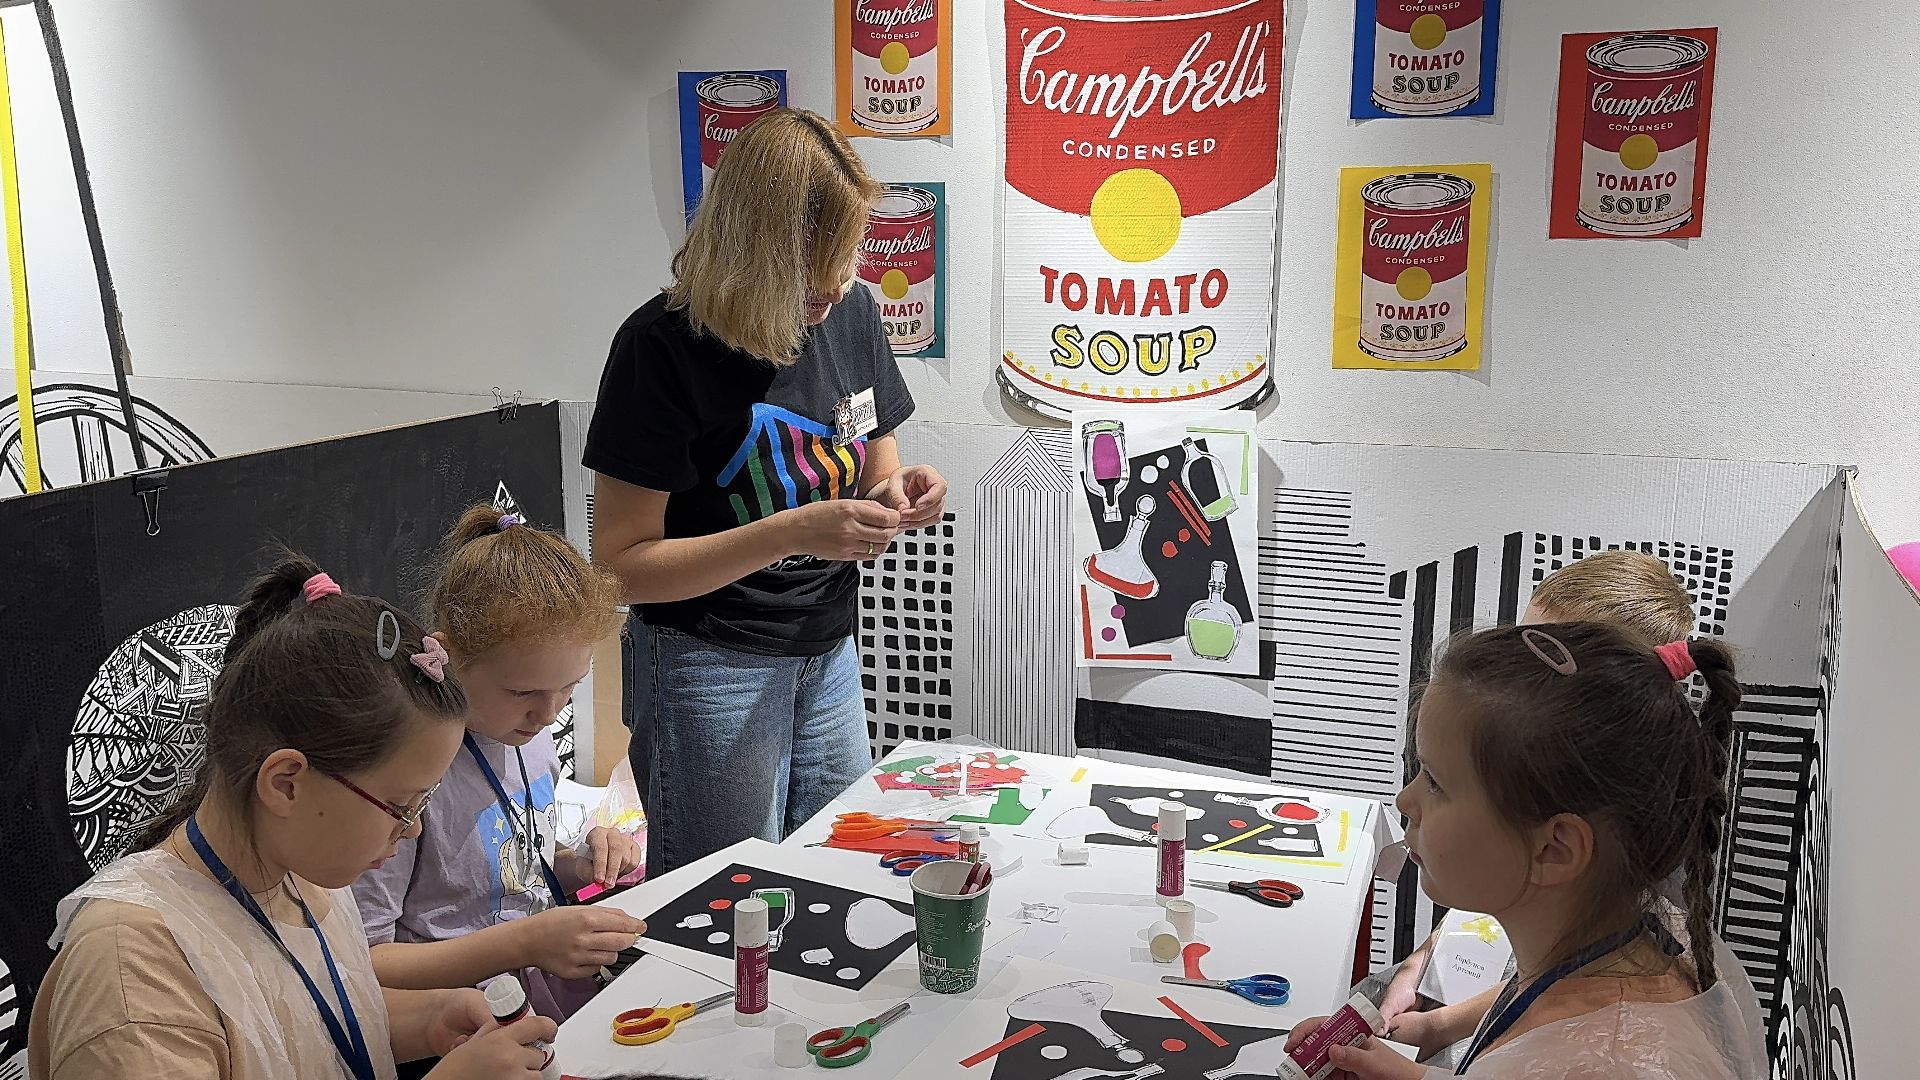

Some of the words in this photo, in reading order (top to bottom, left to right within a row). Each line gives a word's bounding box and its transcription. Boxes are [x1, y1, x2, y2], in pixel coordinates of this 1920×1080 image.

[1399, 2, 1461, 12] CONDENSED
[870, 31, 920, 40] CONDENSED
[1388, 49, 1465, 71] TOMATO
[863, 75, 926, 94] TOMATO
[1019, 20, 1270, 139] Campbell's
[1391, 71, 1460, 95] SOUP
[868, 95, 922, 115] SOUP
[1591, 80, 1697, 124] Campbell's
[1608, 122, 1674, 132] CONDENSED
[1062, 138, 1217, 160] CONDENSED
[1596, 171, 1677, 192] TOMATO
[1599, 193, 1671, 215] SOUP
[1368, 215, 1465, 258] Campbell's
[1385, 255, 1445, 265] CONDENSED
[1039, 264, 1229, 318] TOMATO
[876, 301, 924, 318] MATO
[1375, 301, 1450, 321] TOMATO
[883, 319, 922, 337] OUP
[1379, 322, 1446, 342] SOUP
[1049, 323, 1217, 377] SOUP
